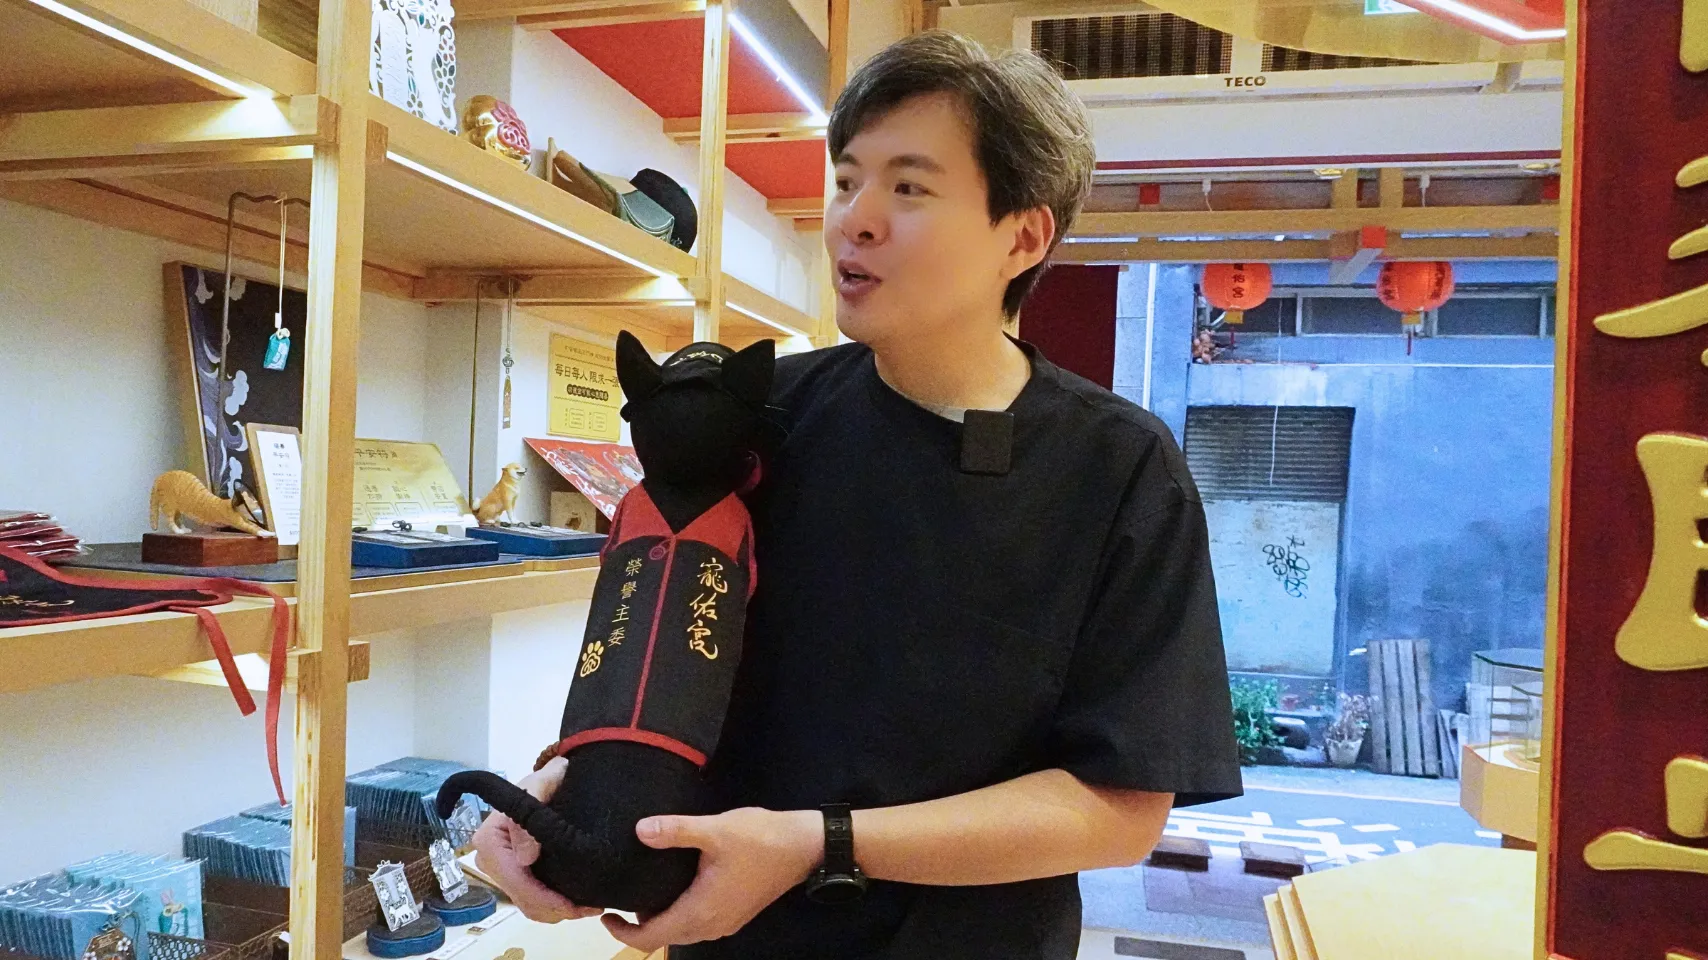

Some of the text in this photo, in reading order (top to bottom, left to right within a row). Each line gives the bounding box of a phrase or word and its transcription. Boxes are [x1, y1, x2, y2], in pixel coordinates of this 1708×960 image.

[1224, 76, 1266, 87] TECO
[608, 558, 643, 647] 榮譽主委
[686, 557, 728, 660] 寵佑宮
